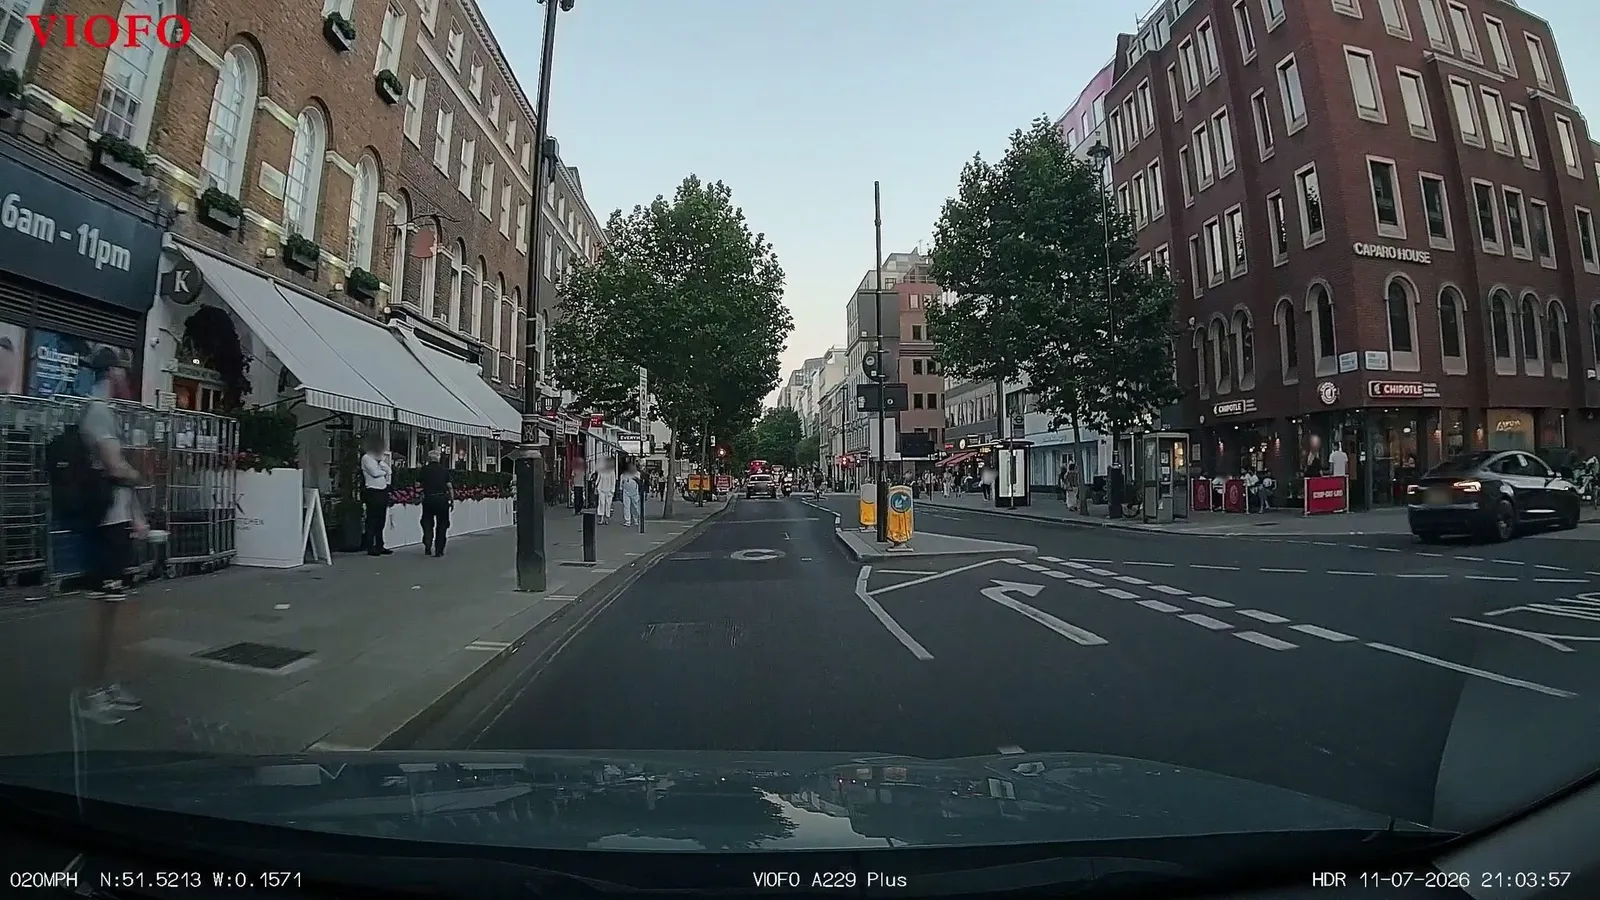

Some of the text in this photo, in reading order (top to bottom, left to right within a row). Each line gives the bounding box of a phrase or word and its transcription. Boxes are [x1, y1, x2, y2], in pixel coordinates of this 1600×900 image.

[1, 193, 56, 244] 6am
[77, 223, 131, 272] 11pm
[1353, 242, 1431, 264] CAPARO HOUSE
[173, 269, 191, 293] K
[1383, 384, 1423, 395] CHIPOTLE
[1218, 402, 1242, 414] CHIPOTLE
